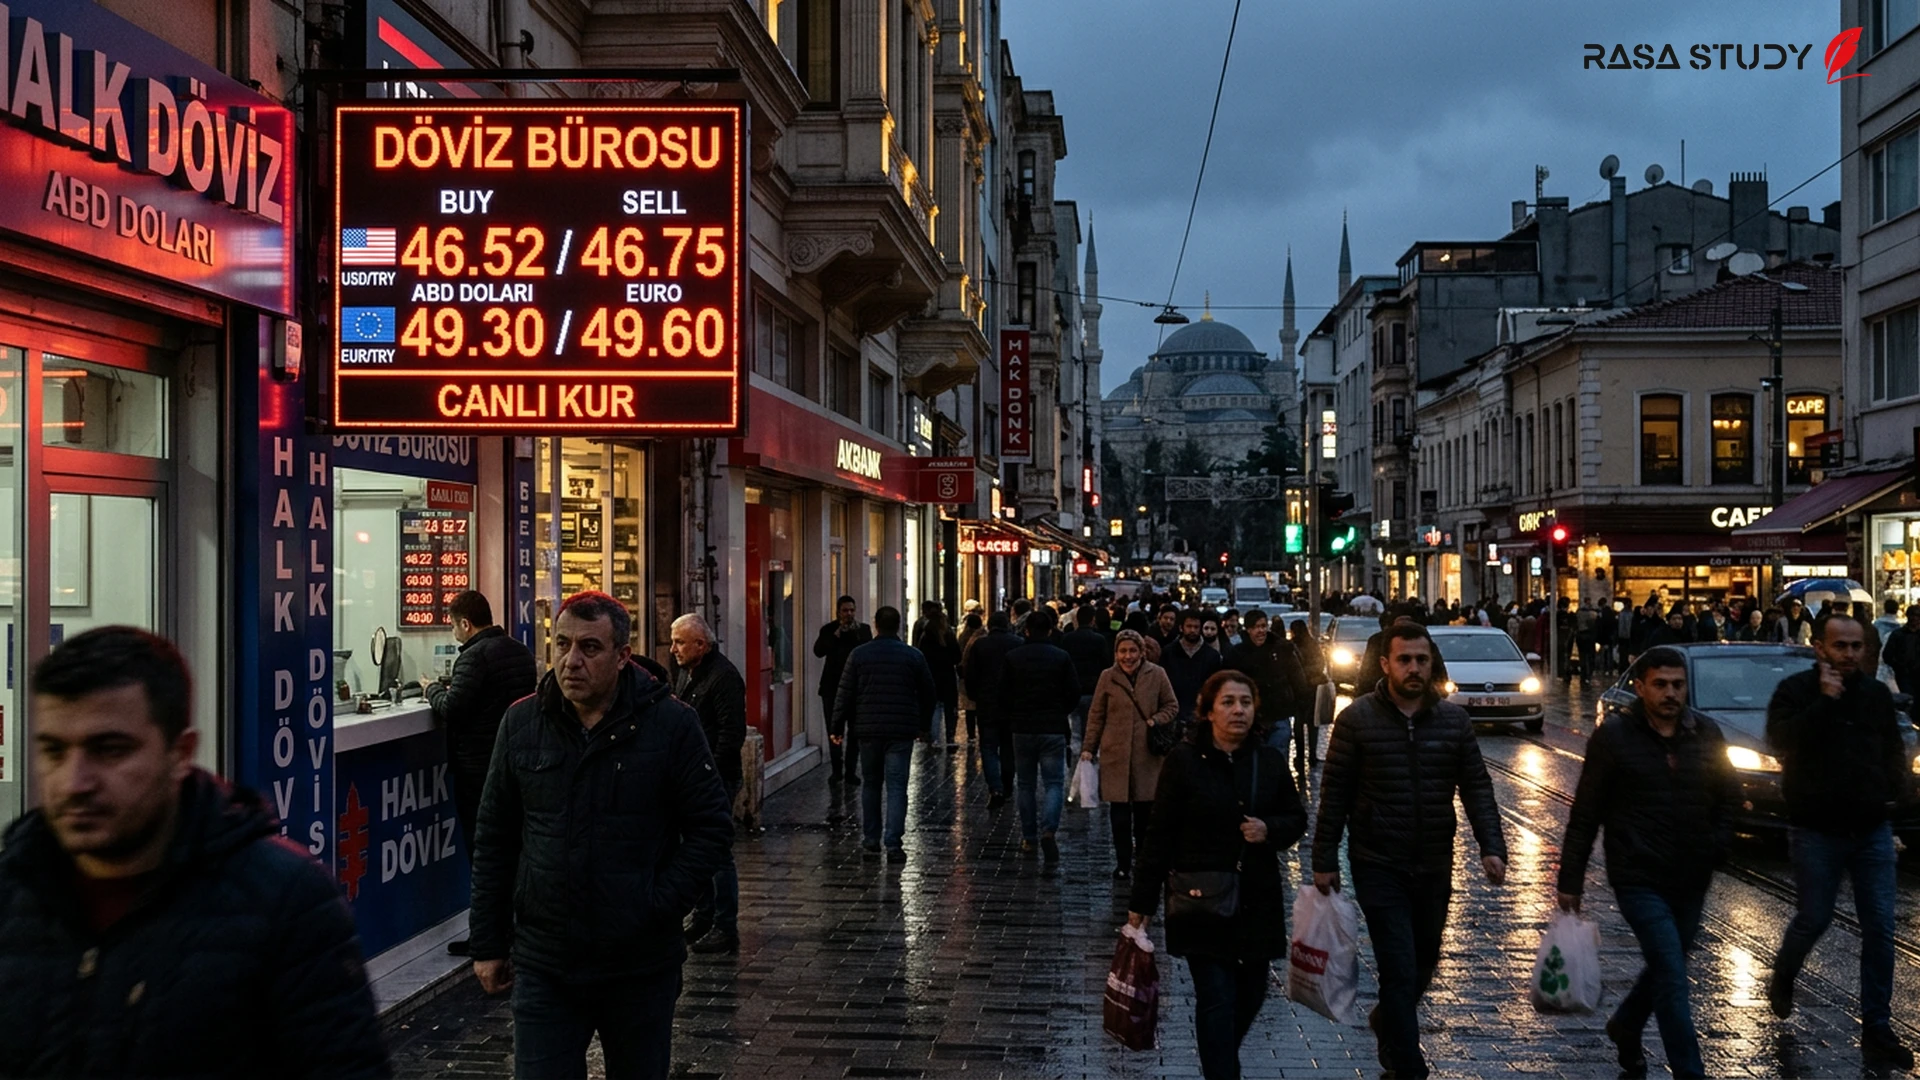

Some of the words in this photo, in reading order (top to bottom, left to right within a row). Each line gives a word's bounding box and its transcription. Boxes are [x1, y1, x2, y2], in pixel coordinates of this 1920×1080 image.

[0, 4, 132, 163] ALK
[148, 76, 283, 224] DÖVİZ
[375, 115, 514, 169] DÖVİZ
[527, 115, 721, 169] BÜROSU
[46, 171, 111, 229] ABD
[119, 196, 216, 266] DOLARI
[440, 190, 494, 214] BUY
[622, 190, 687, 215] SELL
[401, 226, 545, 277] 46.52
[580, 226, 725, 277] 46.75
[341, 271, 396, 286] USD/TRY
[411, 283, 454, 302] ABD
[460, 283, 534, 302] DOLARI
[626, 283, 683, 303] EURO
[341, 348, 396, 364] EUR/TRY
[401, 307, 545, 358] 49.30
[580, 307, 725, 358] 49.60
[437, 384, 546, 418] CANLI
[558, 384, 636, 418] KUR
[836, 439, 882, 481] AKBANK
[273, 436, 295, 632] HALK
[308, 452, 327, 617] HALK
[273, 669, 295, 839] DÖV
[308, 648, 327, 864] DÖVİS
[381, 762, 449, 822] HALK
[381, 813, 456, 884] DÖVİZ
